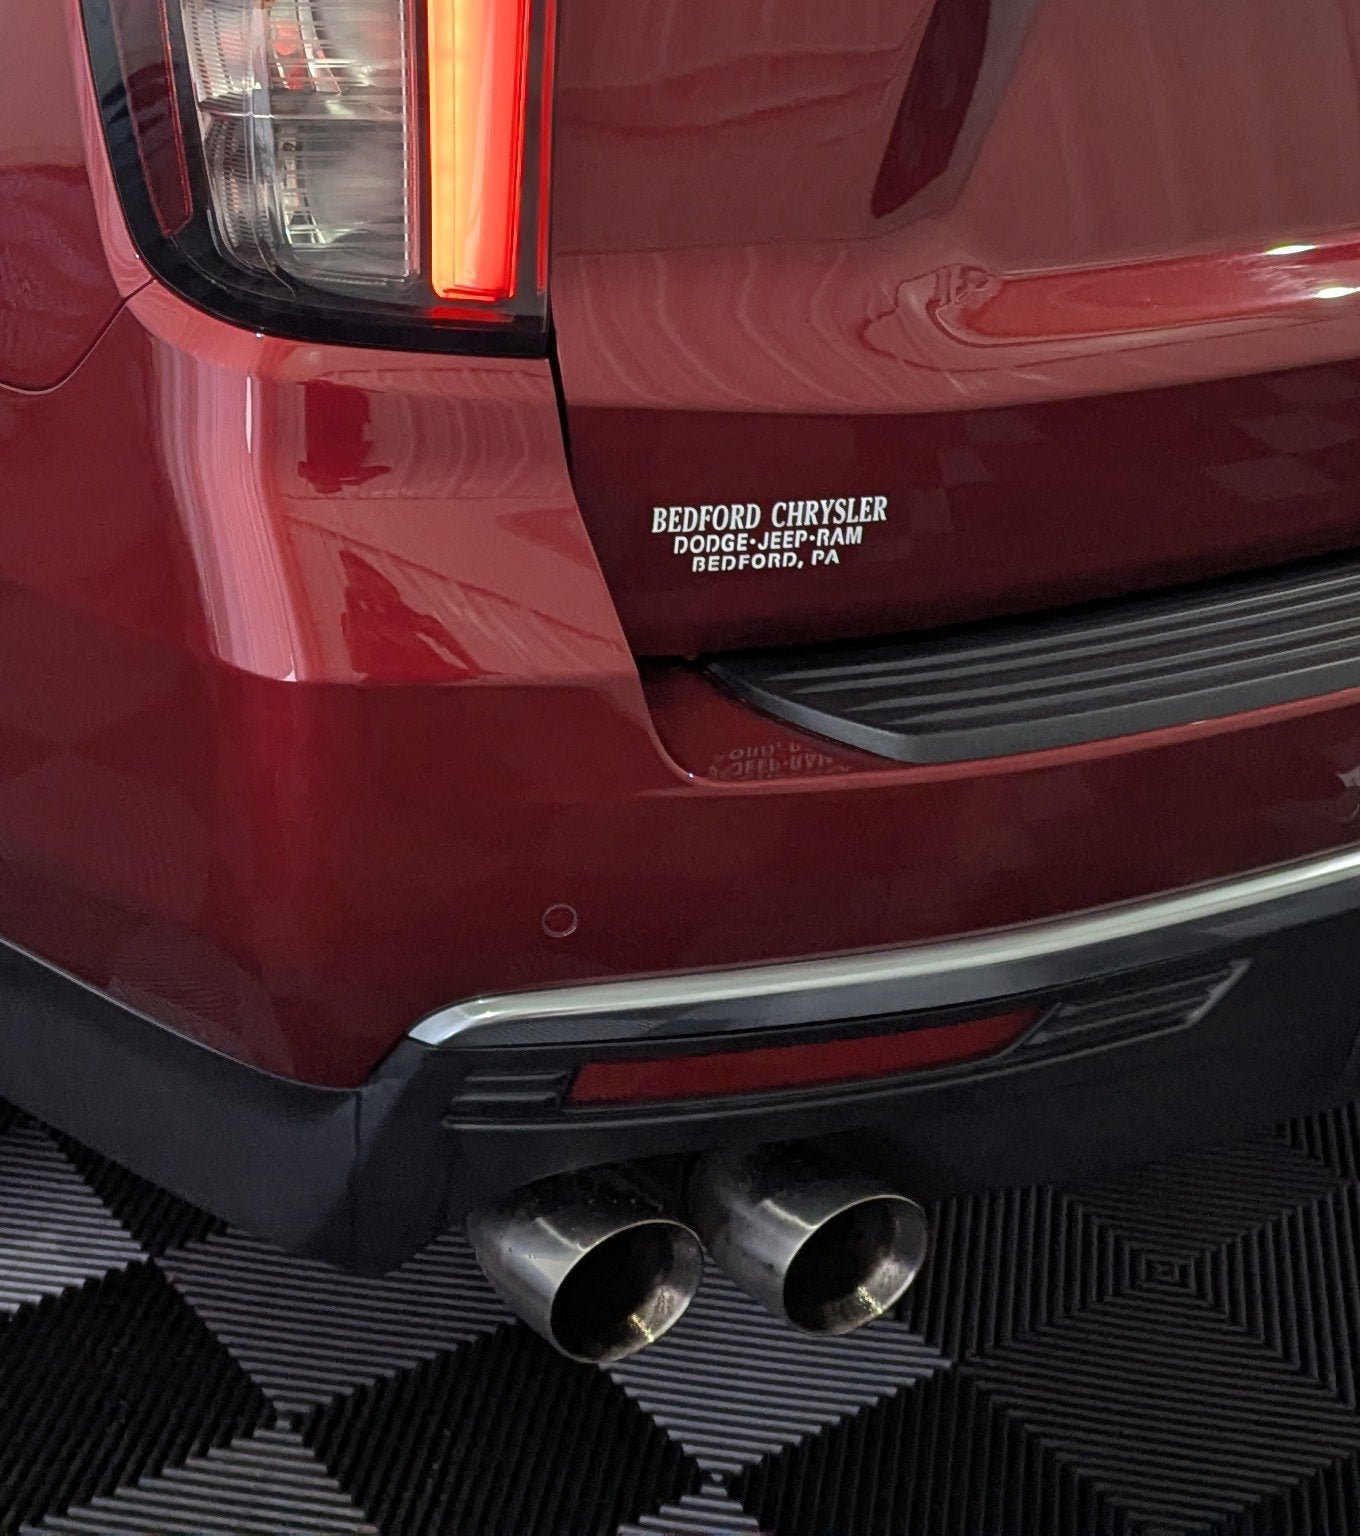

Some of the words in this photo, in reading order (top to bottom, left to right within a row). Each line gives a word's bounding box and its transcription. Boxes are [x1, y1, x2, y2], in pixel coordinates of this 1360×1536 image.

[651, 504, 761, 533] BEDFORD
[771, 496, 887, 528] CHRYSLER
[692, 552, 803, 572] BEDFORD,
[811, 549, 840, 566] PA
